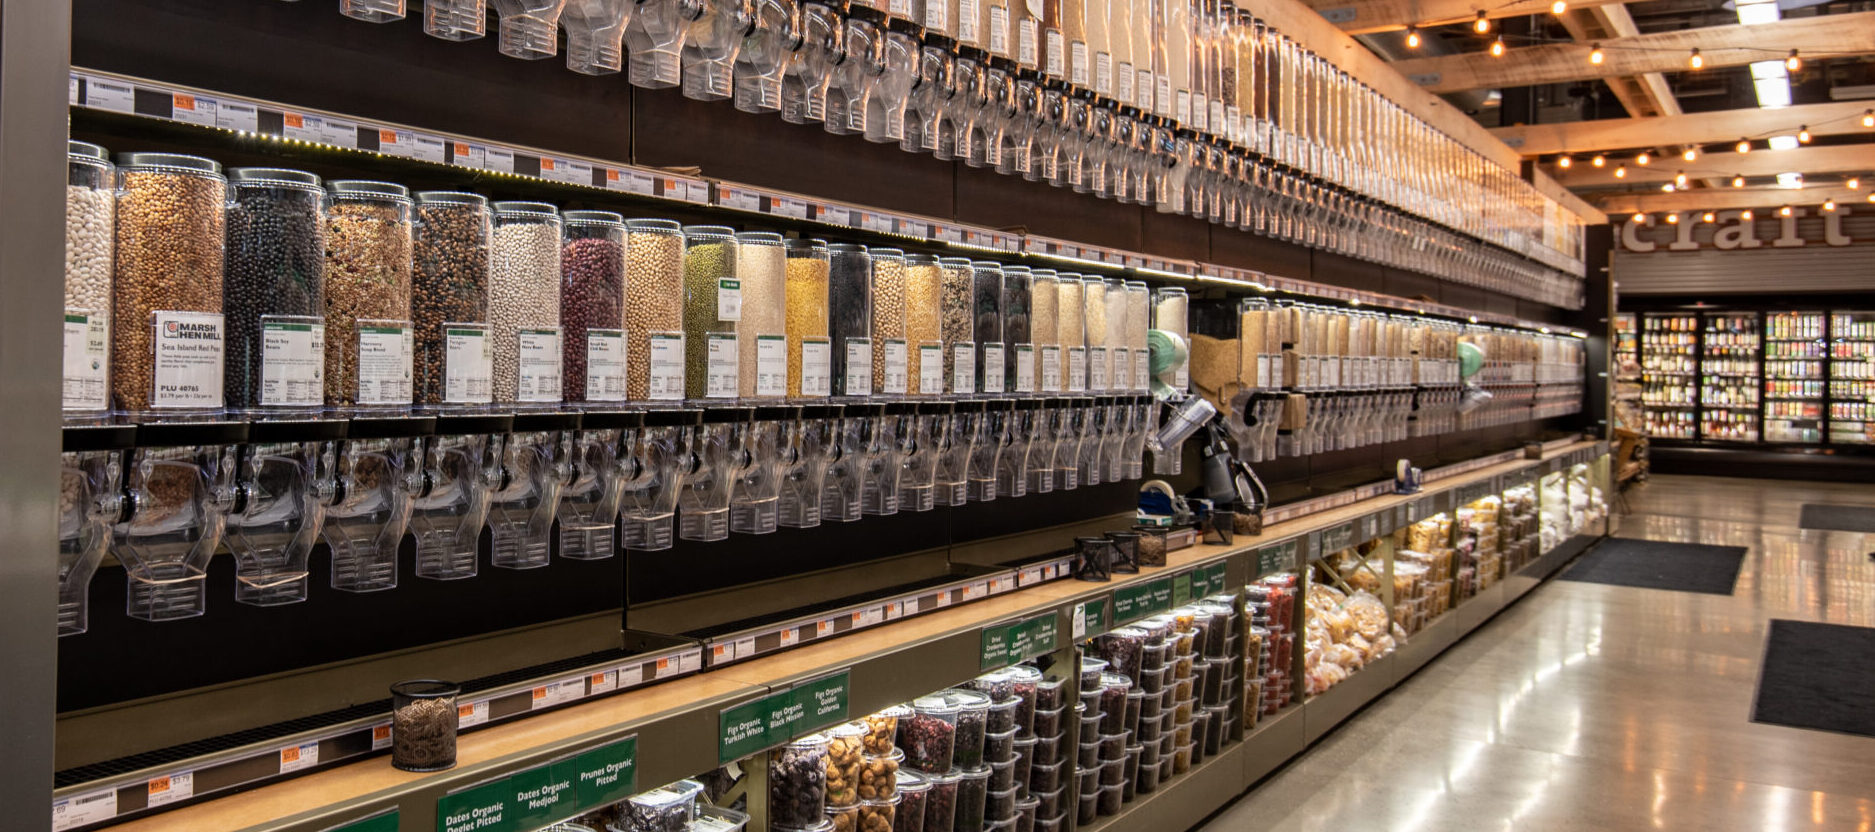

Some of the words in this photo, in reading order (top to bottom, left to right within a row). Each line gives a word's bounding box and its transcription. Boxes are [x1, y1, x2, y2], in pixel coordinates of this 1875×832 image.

[1621, 207, 1852, 252] craft
[180, 324, 216, 332] MARSH
[180, 331, 203, 339] HEN
[162, 343, 175, 351] Sea
[816, 691, 826, 700] Figs
[826, 685, 844, 696] Organic
[817, 703, 840, 715] California
[820, 696, 837, 706] Golden
[772, 710, 783, 720] Figs
[783, 703, 803, 715] Organic
[727, 727, 739, 737] Figs
[739, 718, 761, 731] Organic
[770, 719, 785, 729] Black
[785, 711, 804, 723] Mission
[724, 733, 746, 745] Turkish
[746, 726, 764, 737] White
[580, 768, 605, 781] Prunes
[606, 758, 632, 775] Organic
[596, 773, 618, 787] Pitted
[518, 789, 541, 802] Dates
[542, 779, 570, 796] Organic
[529, 794, 559, 810] Medjool
[446, 814, 470, 826] Dates
[472, 801, 503, 818] Organic
[476, 813, 502, 828] Pitted
